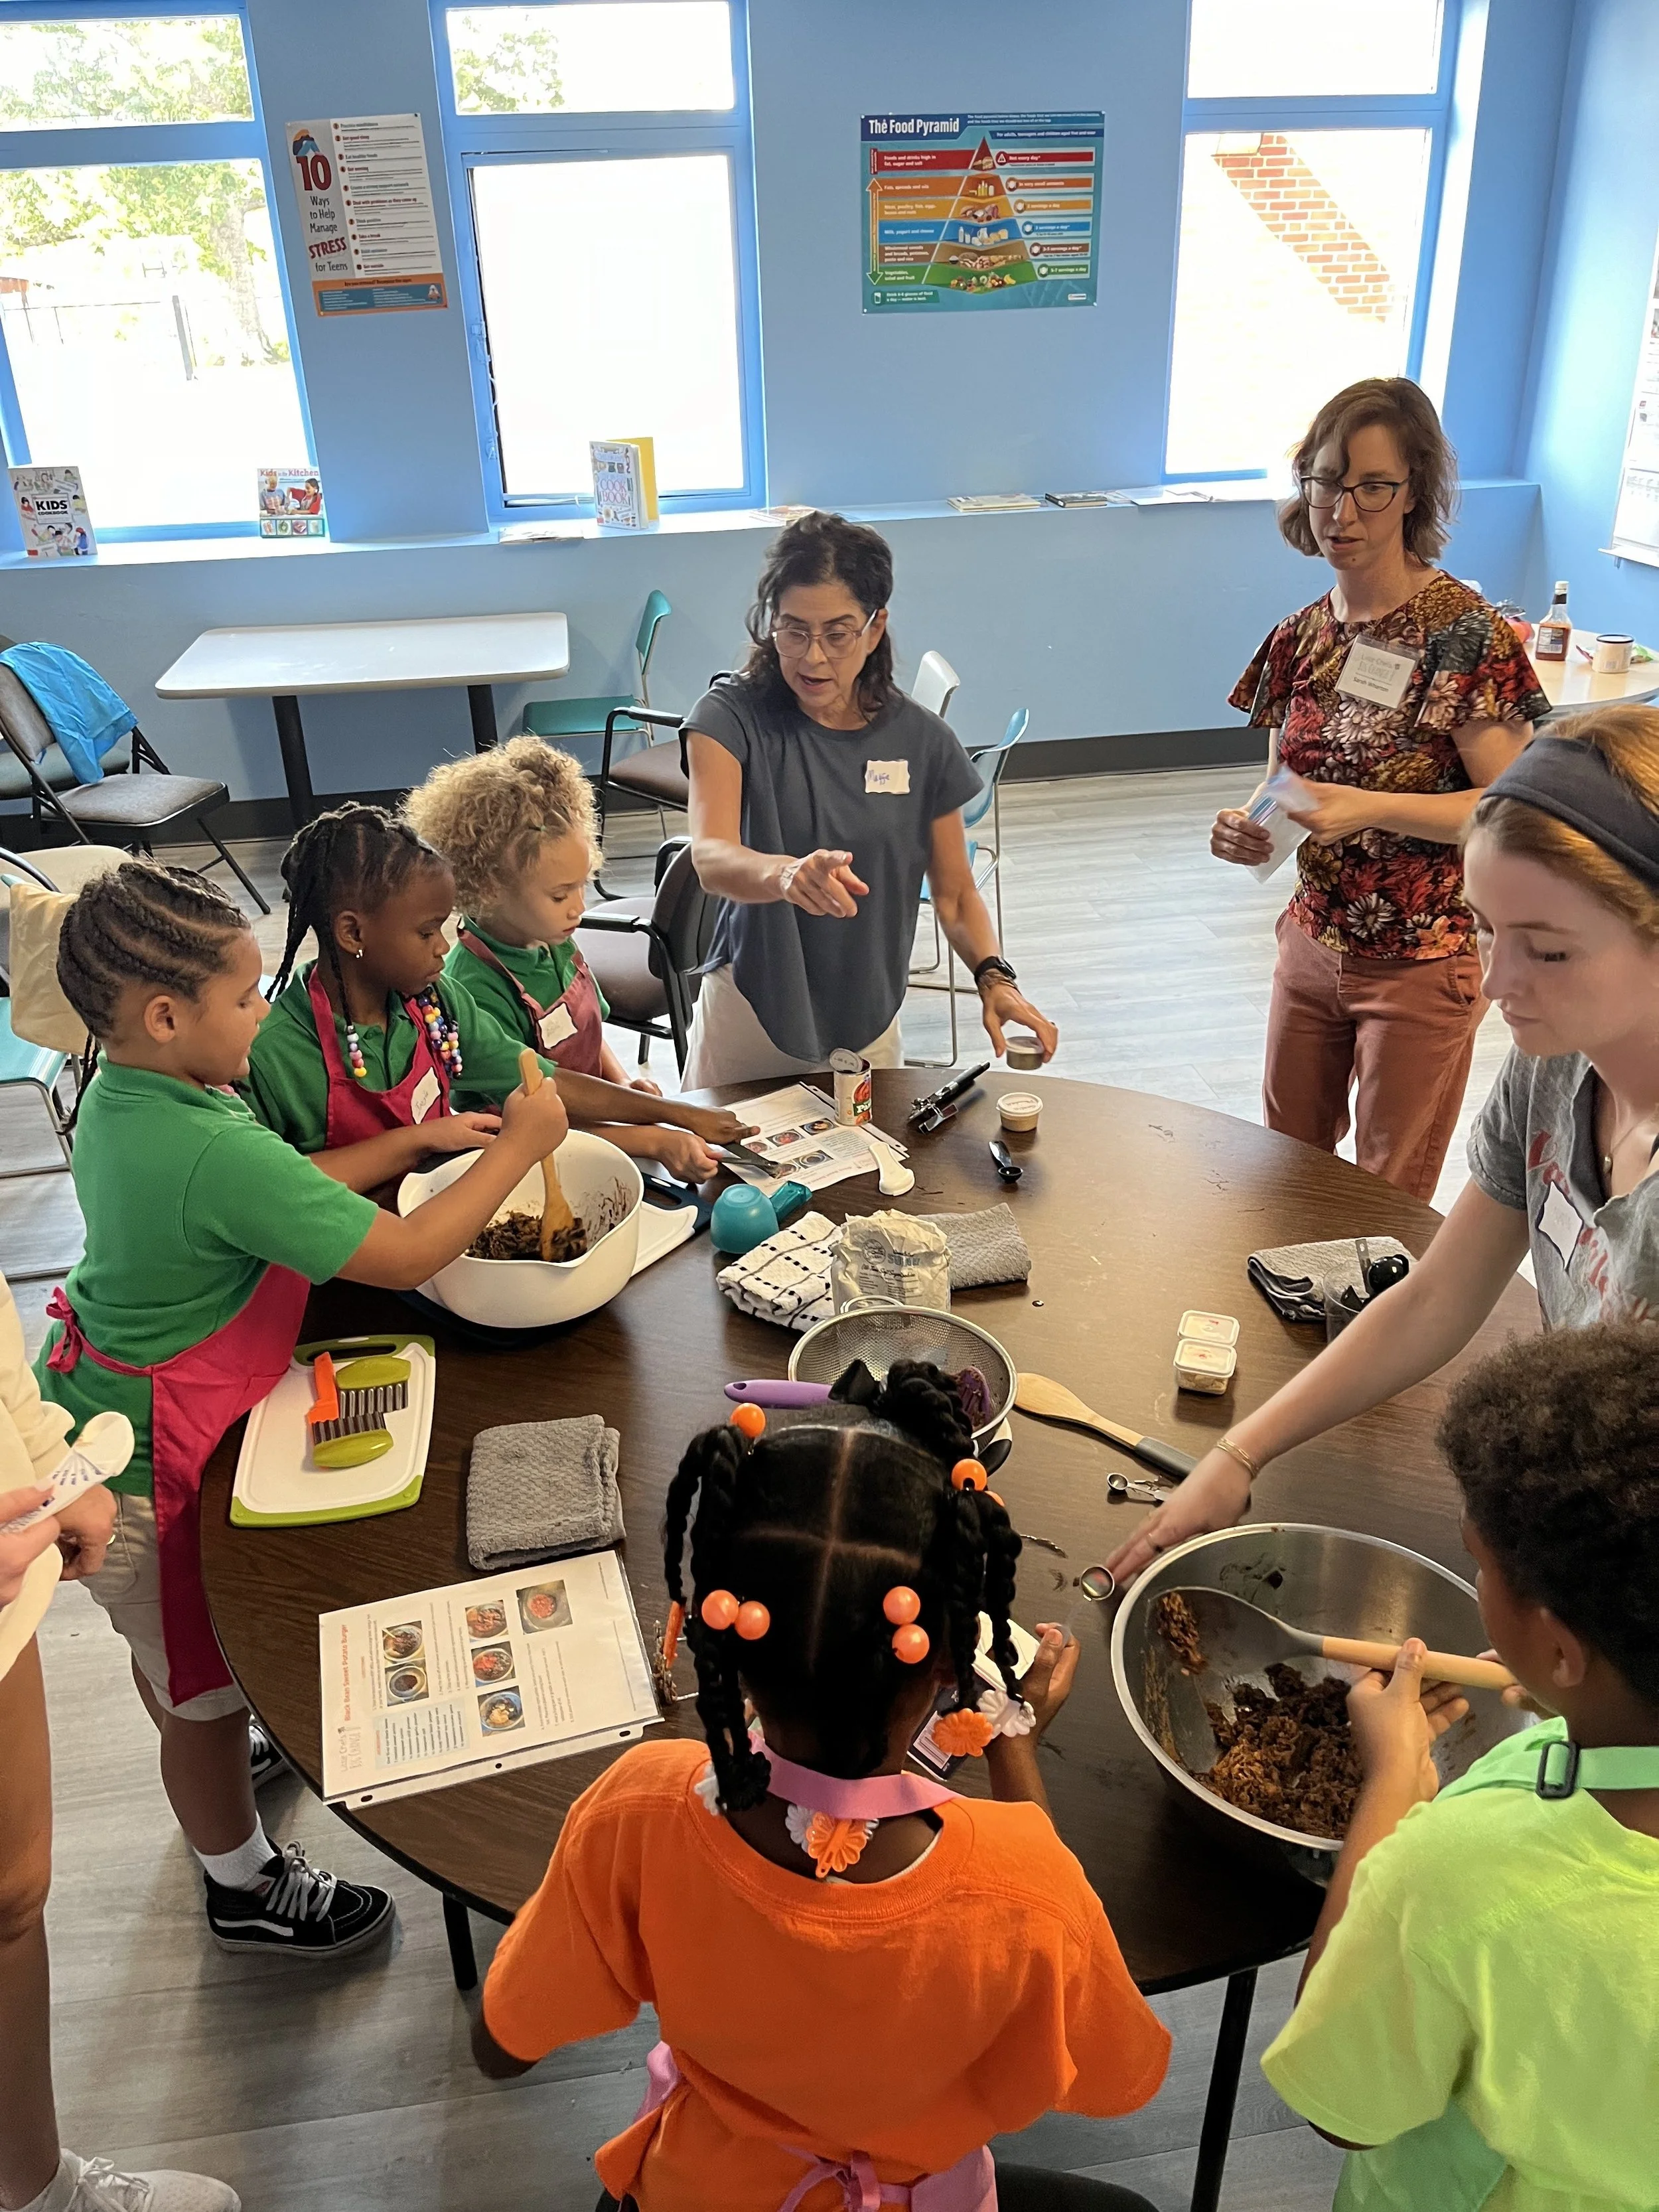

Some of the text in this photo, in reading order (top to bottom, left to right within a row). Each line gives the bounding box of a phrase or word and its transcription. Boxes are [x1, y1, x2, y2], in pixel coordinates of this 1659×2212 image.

[869, 118, 960, 136] The Food Pyramid
[296, 155, 332, 191] 10
[309, 195, 330, 208] Ways
[309, 208, 335, 221] to Help
[309, 223, 338, 234] Manage
[309, 236, 347, 259] STRESS
[315, 261, 348, 272] for Teens
[600, 478, 627, 492] COOK
[36, 500, 68, 511] KIDS
